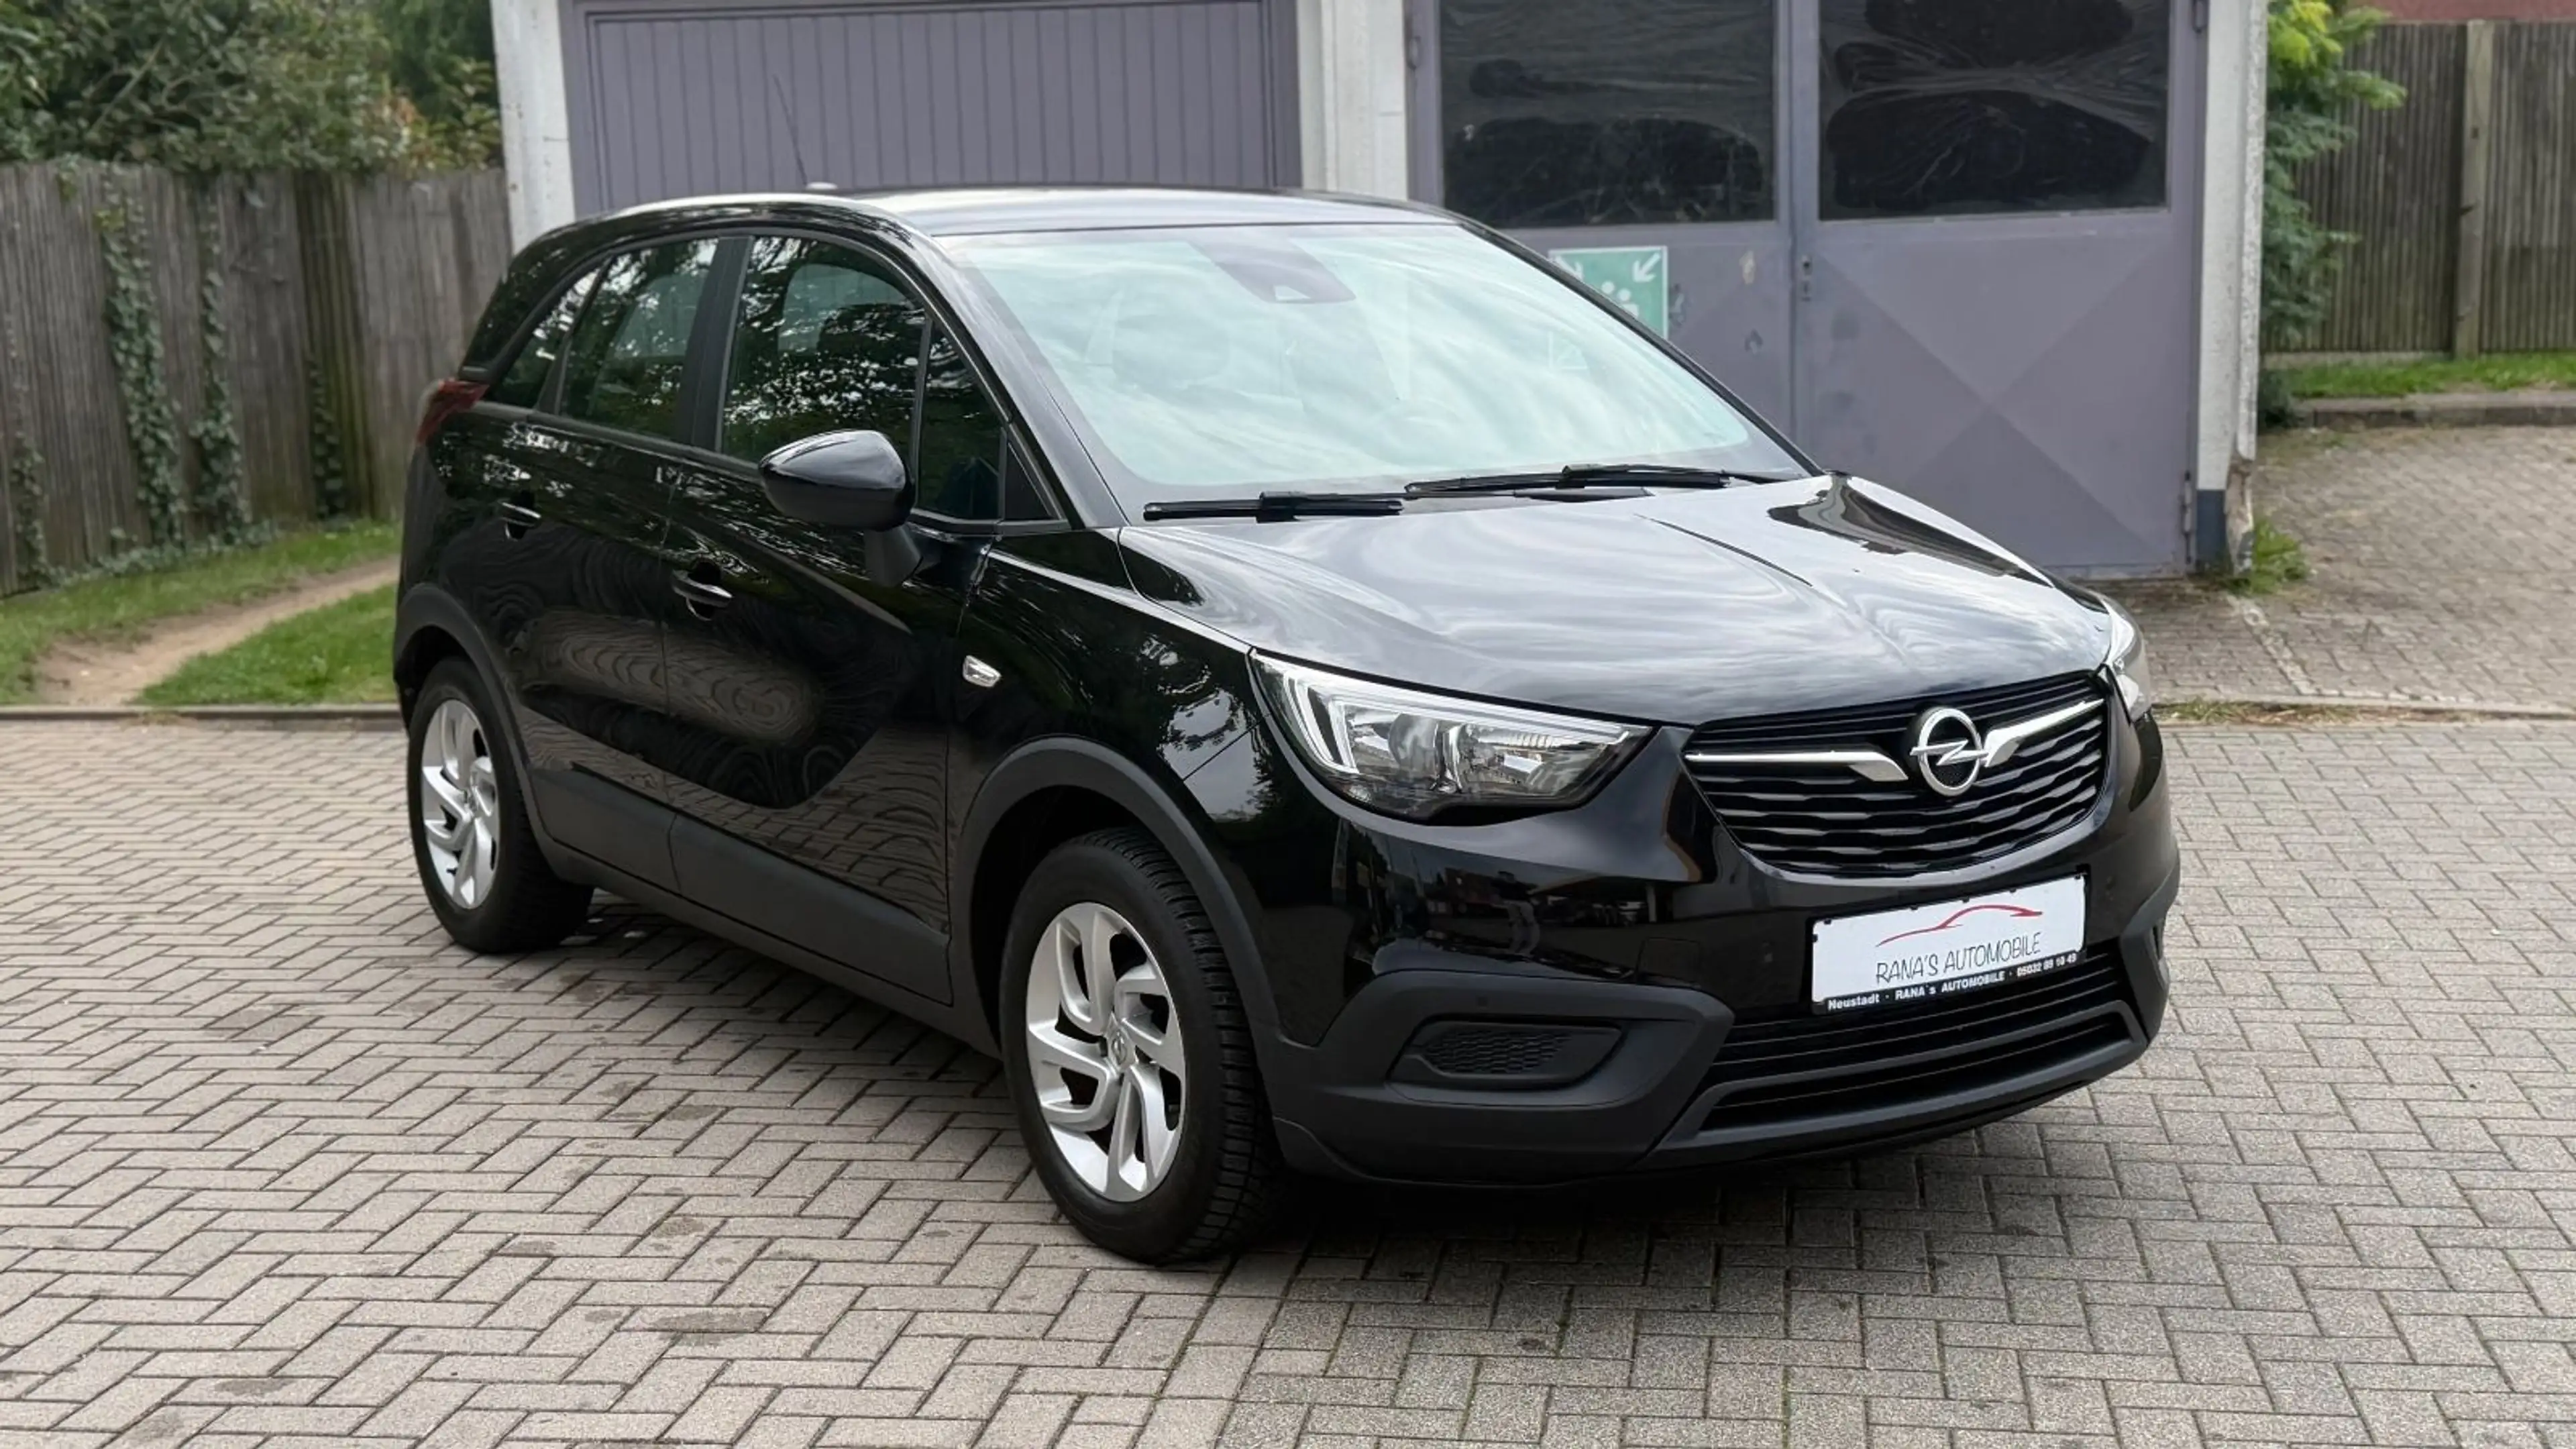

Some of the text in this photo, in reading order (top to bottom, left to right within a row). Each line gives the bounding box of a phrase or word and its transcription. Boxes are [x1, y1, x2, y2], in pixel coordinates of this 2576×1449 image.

[1876, 932, 2041, 983] RANA'S AUTOMOBILE
[1827, 994, 1880, 1011] Neustadt
[1941, 971, 2005, 992] AUTOMOBILE
